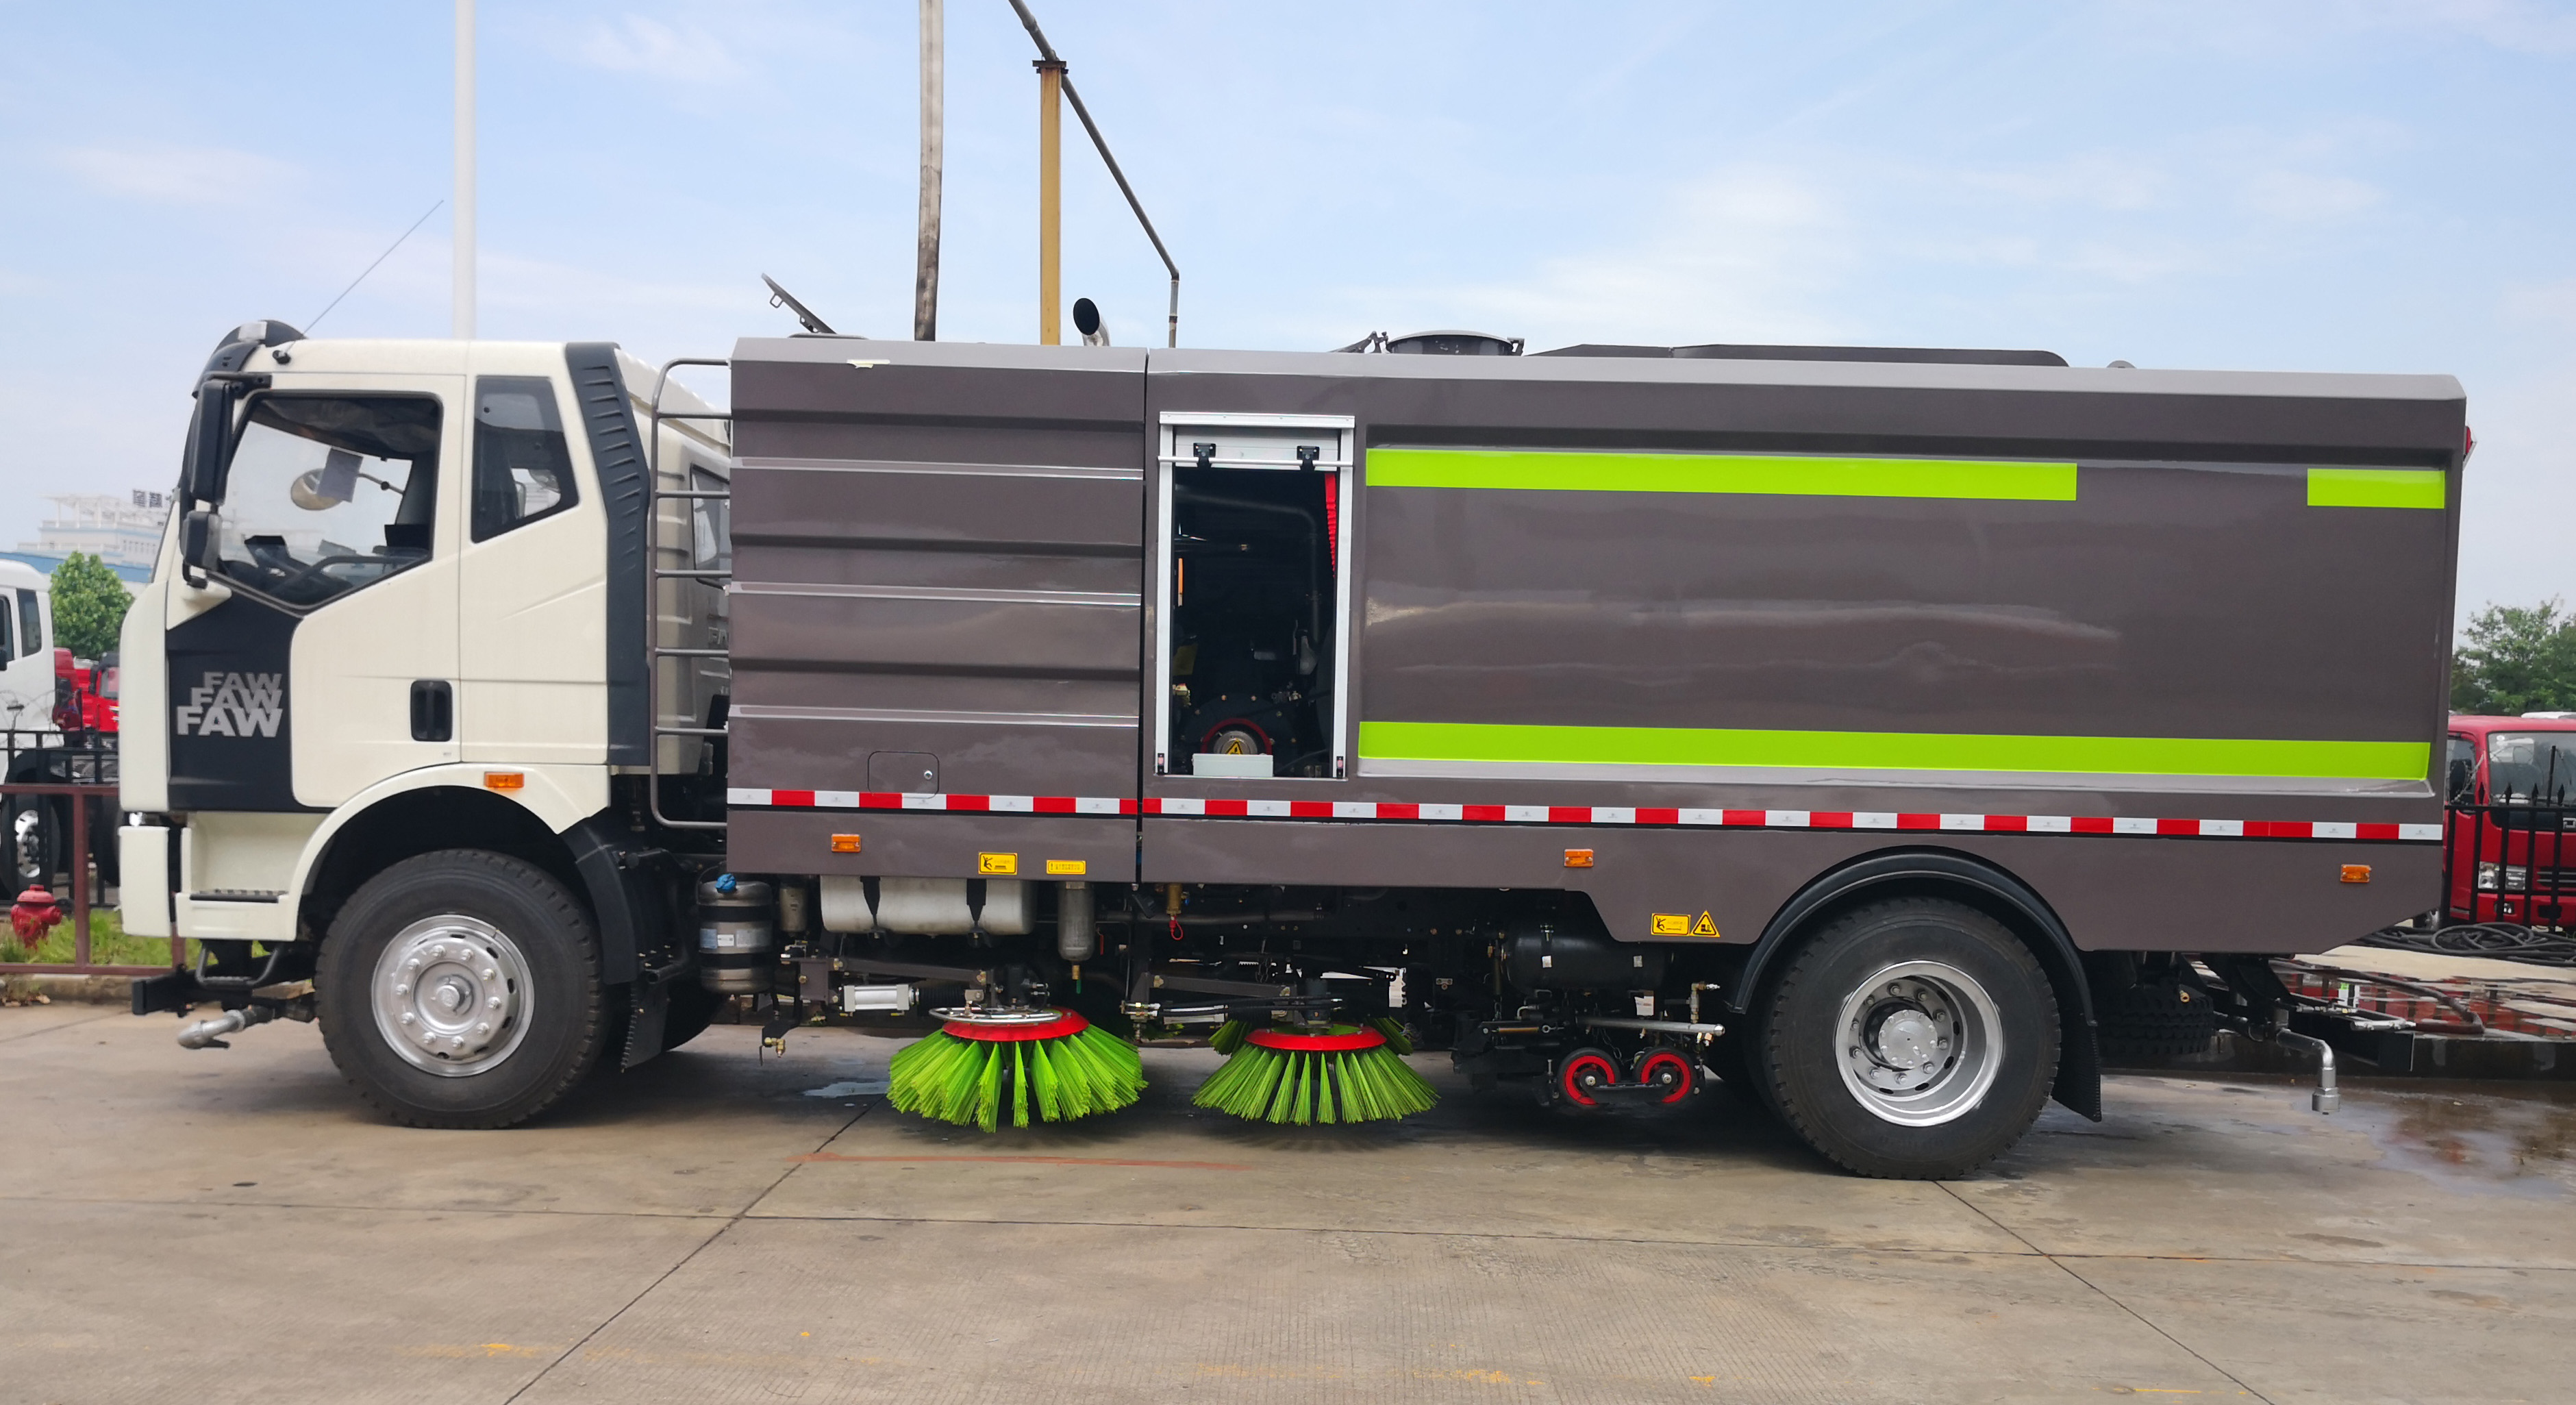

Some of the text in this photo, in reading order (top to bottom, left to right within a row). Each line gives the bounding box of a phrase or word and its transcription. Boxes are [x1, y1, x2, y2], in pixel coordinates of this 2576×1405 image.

[204, 671, 282, 695] FAW
[191, 687, 282, 713] FAW
[177, 706, 283, 738] FAW
